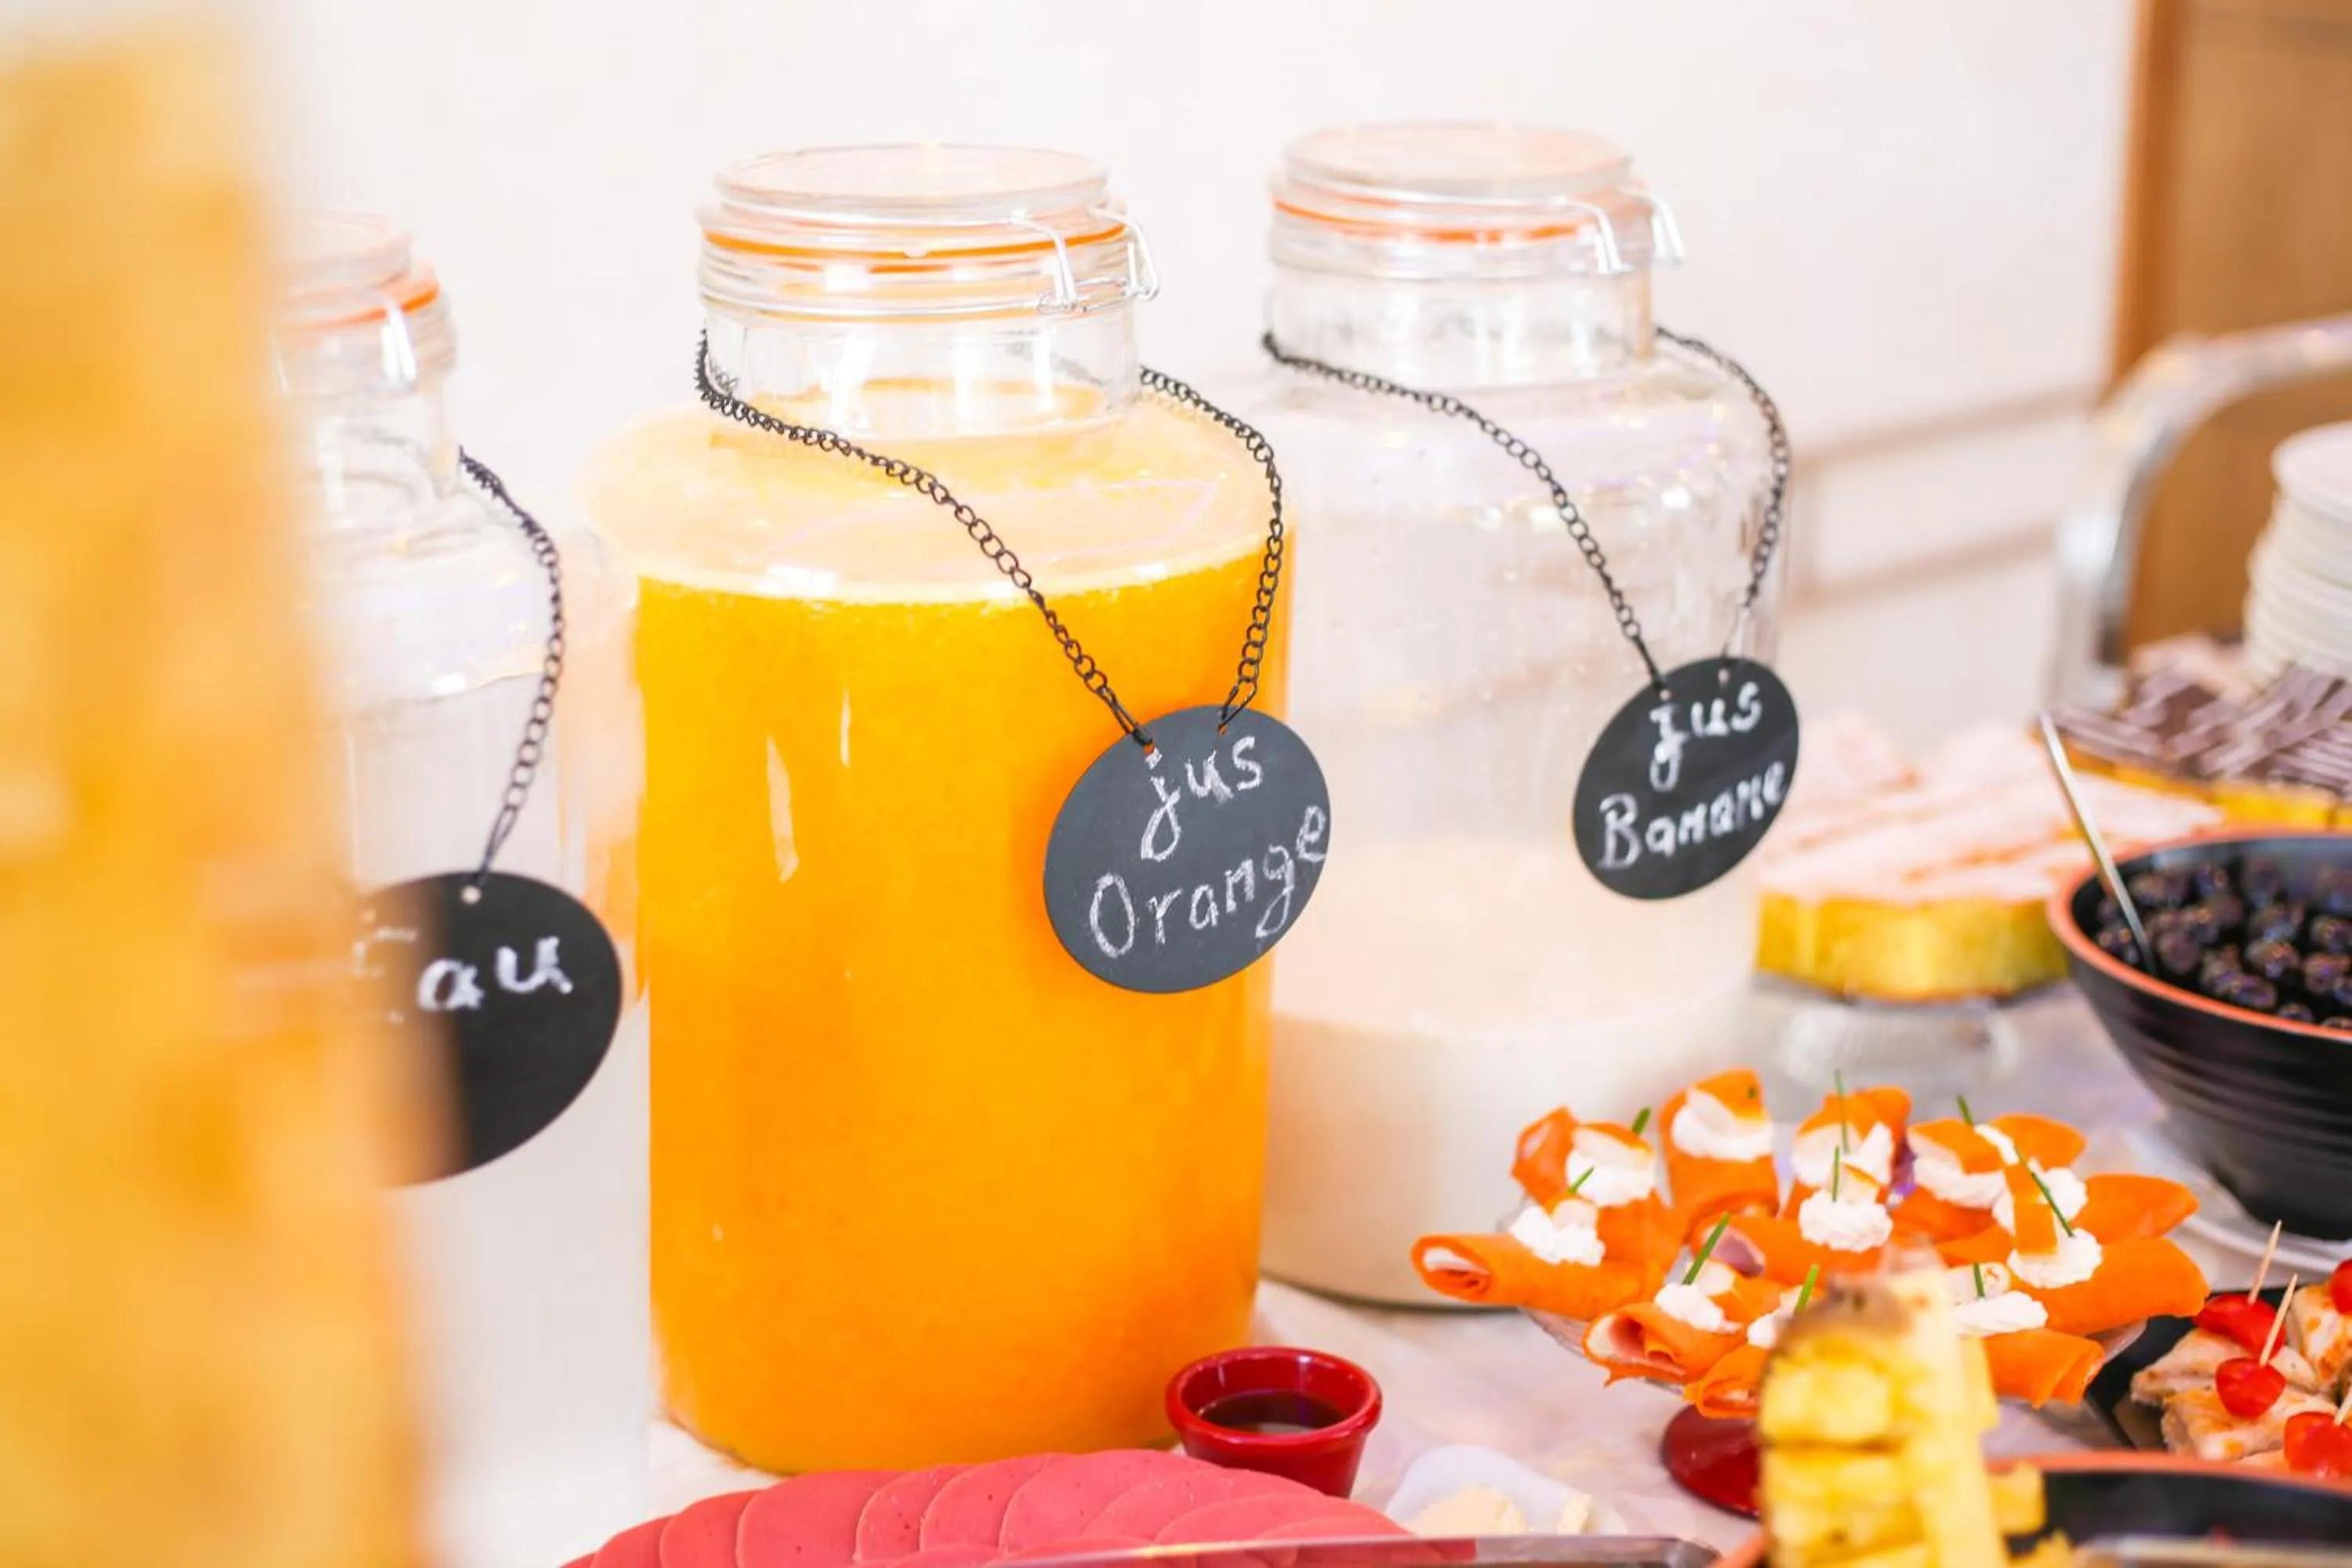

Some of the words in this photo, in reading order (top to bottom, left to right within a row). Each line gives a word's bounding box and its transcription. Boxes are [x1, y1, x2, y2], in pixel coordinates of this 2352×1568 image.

[1649, 681, 1762, 792] jus
[1140, 735, 1264, 862] jus
[1596, 760, 1784, 869] Banane
[1089, 805, 1327, 958] Orange
